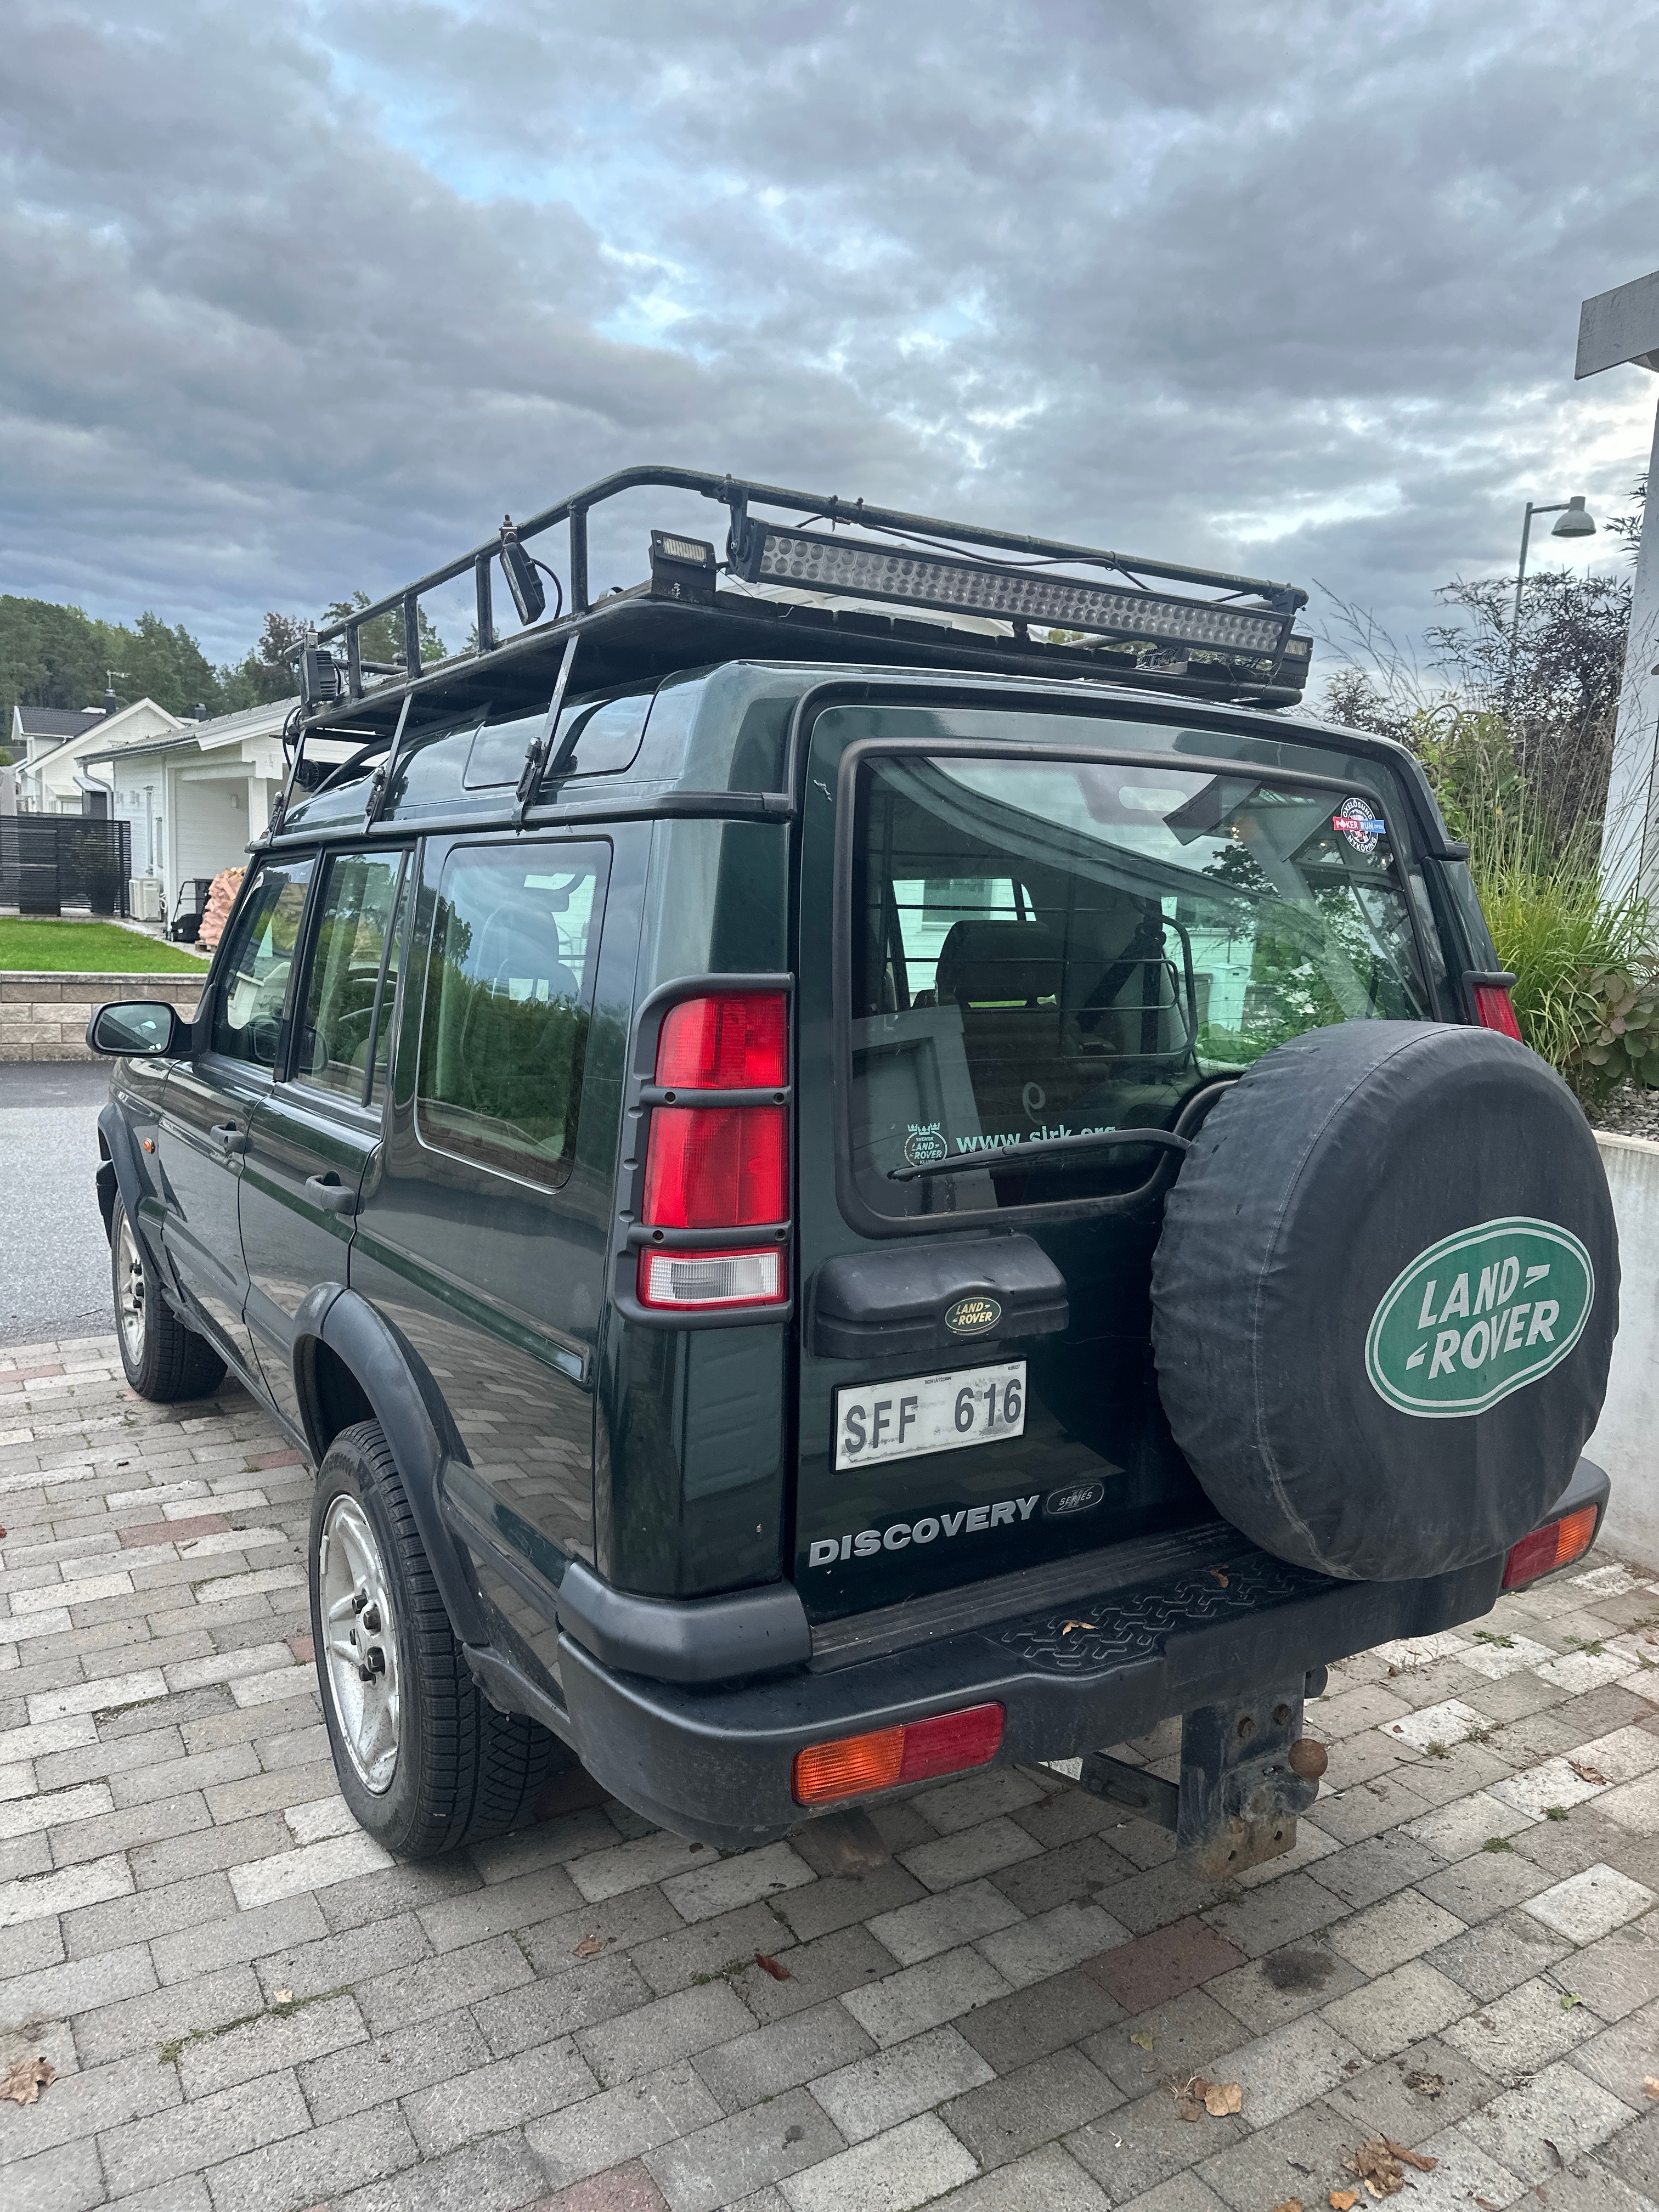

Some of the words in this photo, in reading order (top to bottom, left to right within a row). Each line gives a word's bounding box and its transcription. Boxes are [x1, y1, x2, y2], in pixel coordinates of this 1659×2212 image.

[1342, 799, 1373, 820] OXELÖSUND
[1360, 822, 1374, 831] RUN
[1347, 834, 1376, 851] NYKÖPING
[956, 1125, 1116, 1153] wwwslrk
[845, 1396, 918, 1453] SFF
[955, 1379, 1022, 1432] 616
[1059, 1492, 1093, 1505] SERIES
[809, 1494, 1040, 1567] DISCOVERY
